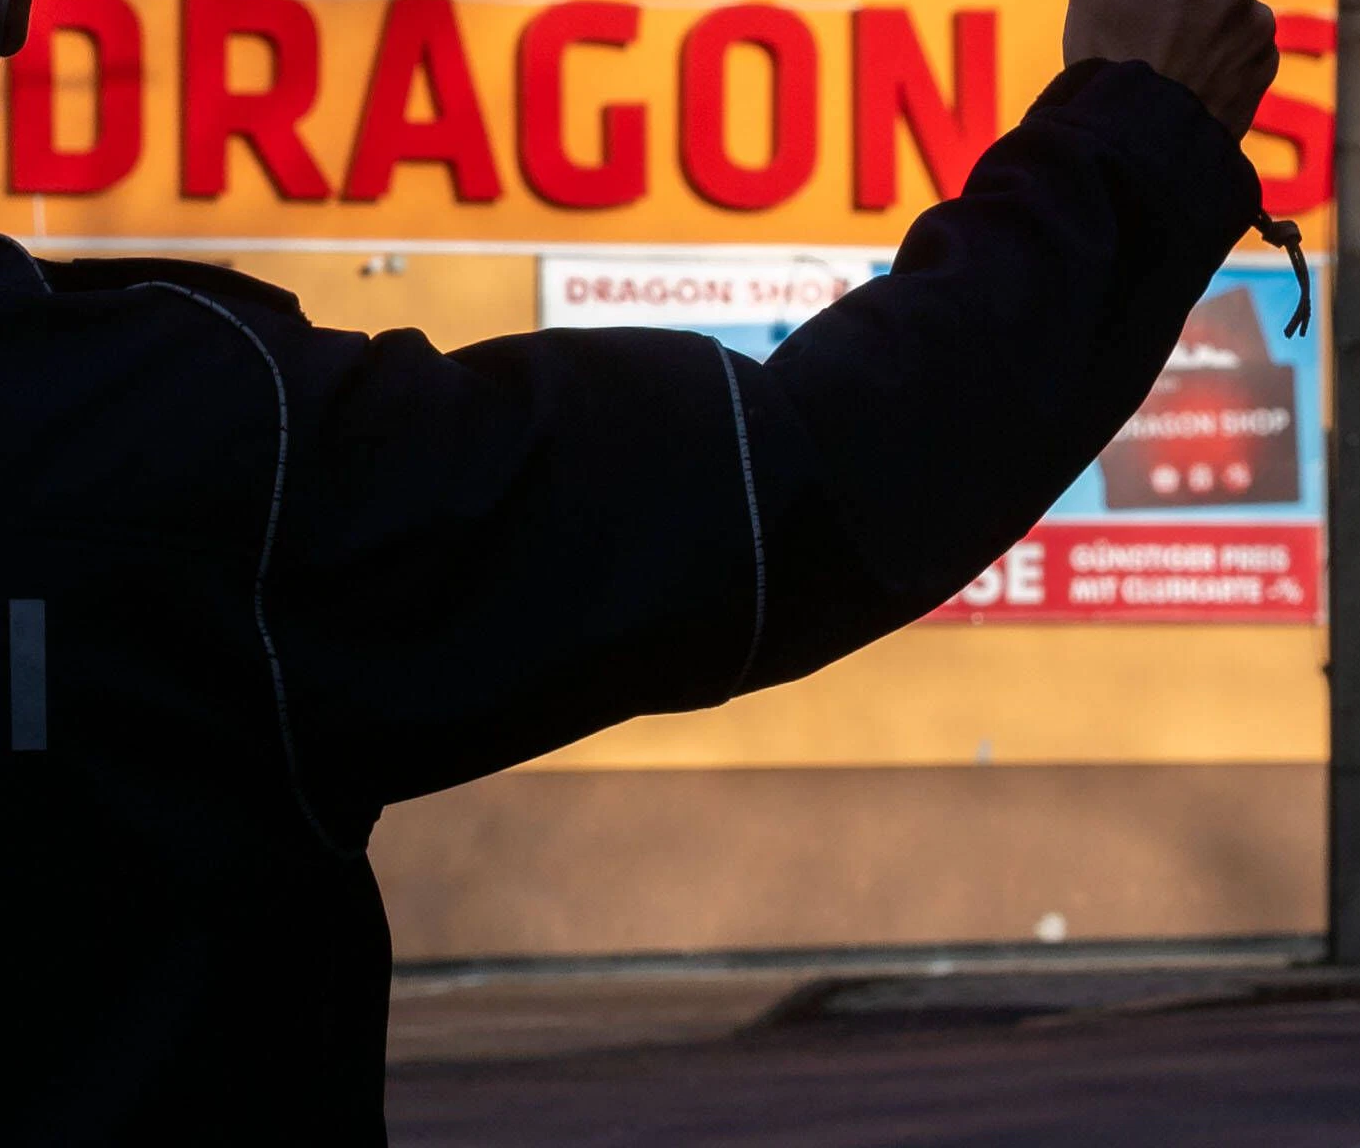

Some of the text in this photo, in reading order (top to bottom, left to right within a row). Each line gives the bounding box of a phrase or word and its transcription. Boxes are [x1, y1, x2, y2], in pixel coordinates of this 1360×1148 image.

[564, 276, 734, 305] DRAGON
[1220, 543, 1291, 572] PREIS
[1068, 575, 1118, 604] MIT
